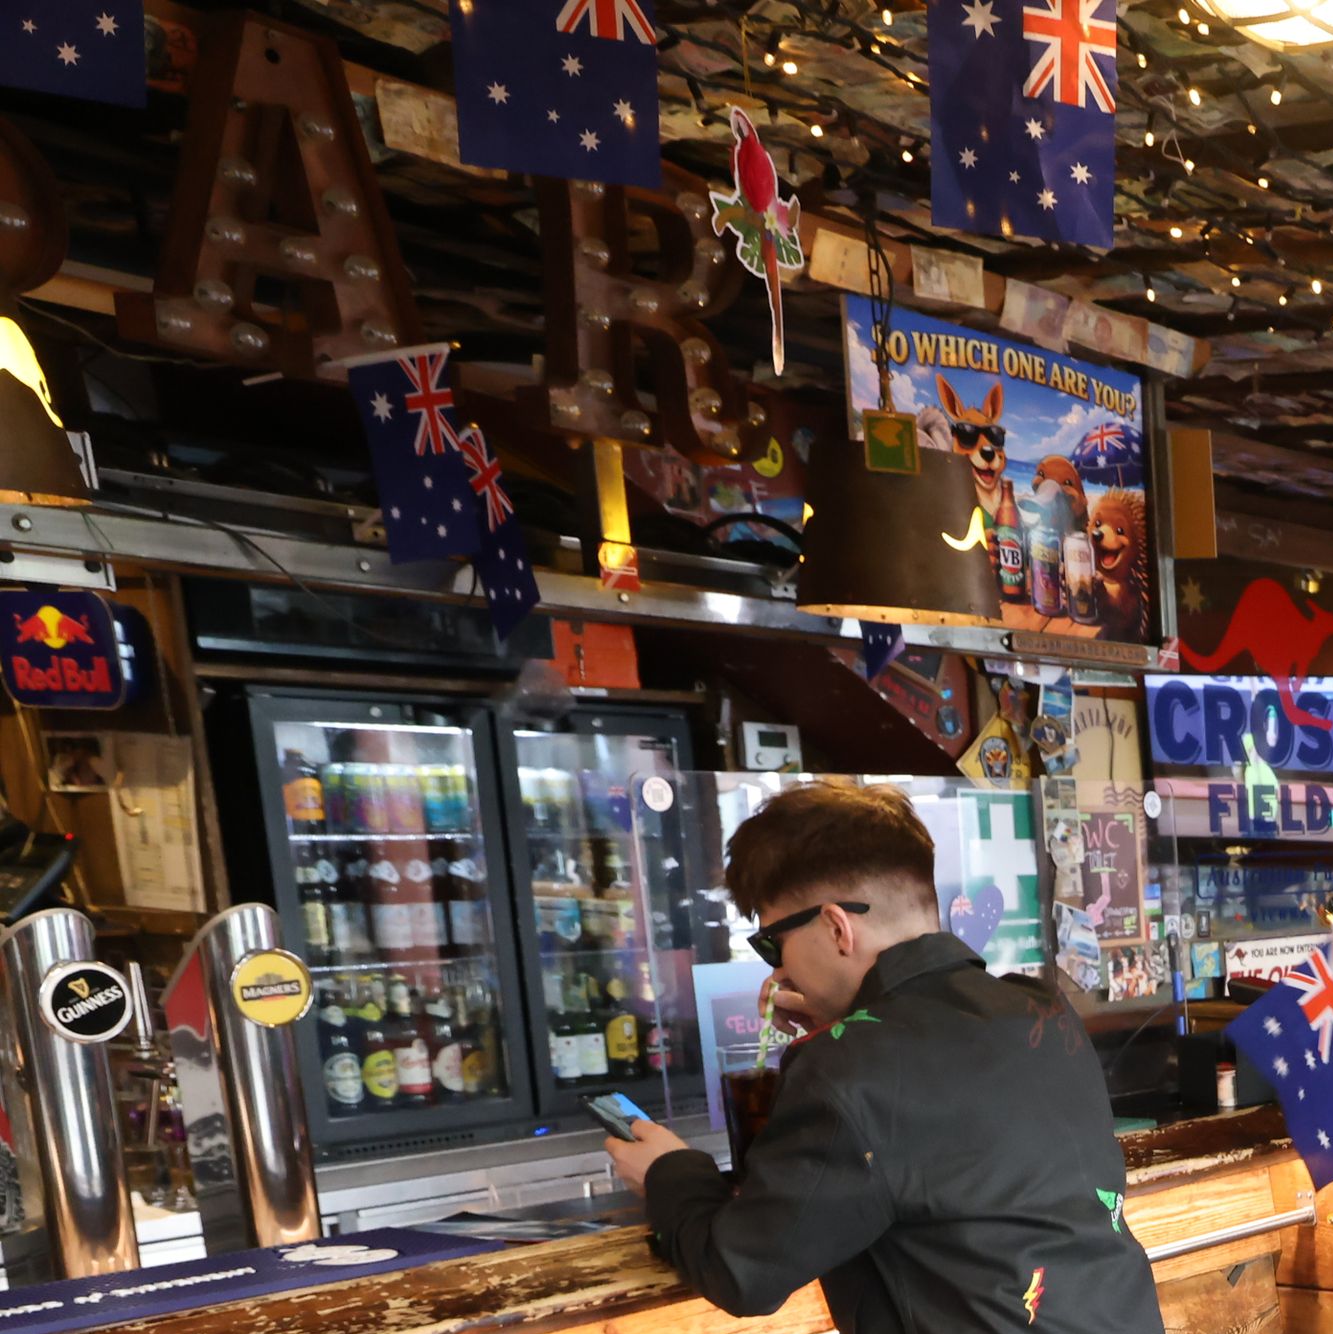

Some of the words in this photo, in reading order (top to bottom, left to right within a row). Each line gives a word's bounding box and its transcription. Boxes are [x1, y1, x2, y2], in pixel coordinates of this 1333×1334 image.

[911, 330, 1000, 374] WHICH
[1003, 347, 1047, 385] ONE
[1048, 360, 1090, 401] ARE
[1091, 377, 1137, 421] YOU?
[1001, 548, 1022, 566] VB
[12, 656, 61, 691] Red
[64, 656, 112, 693] Bull
[1082, 818, 1120, 849] WC
[1251, 949, 1264, 958] YOU
[1265, 947, 1278, 956] ARE
[1280, 946, 1295, 955] NOW
[57, 985, 123, 1026] GUINNESS
[242, 981, 301, 1000] MAGNERS
